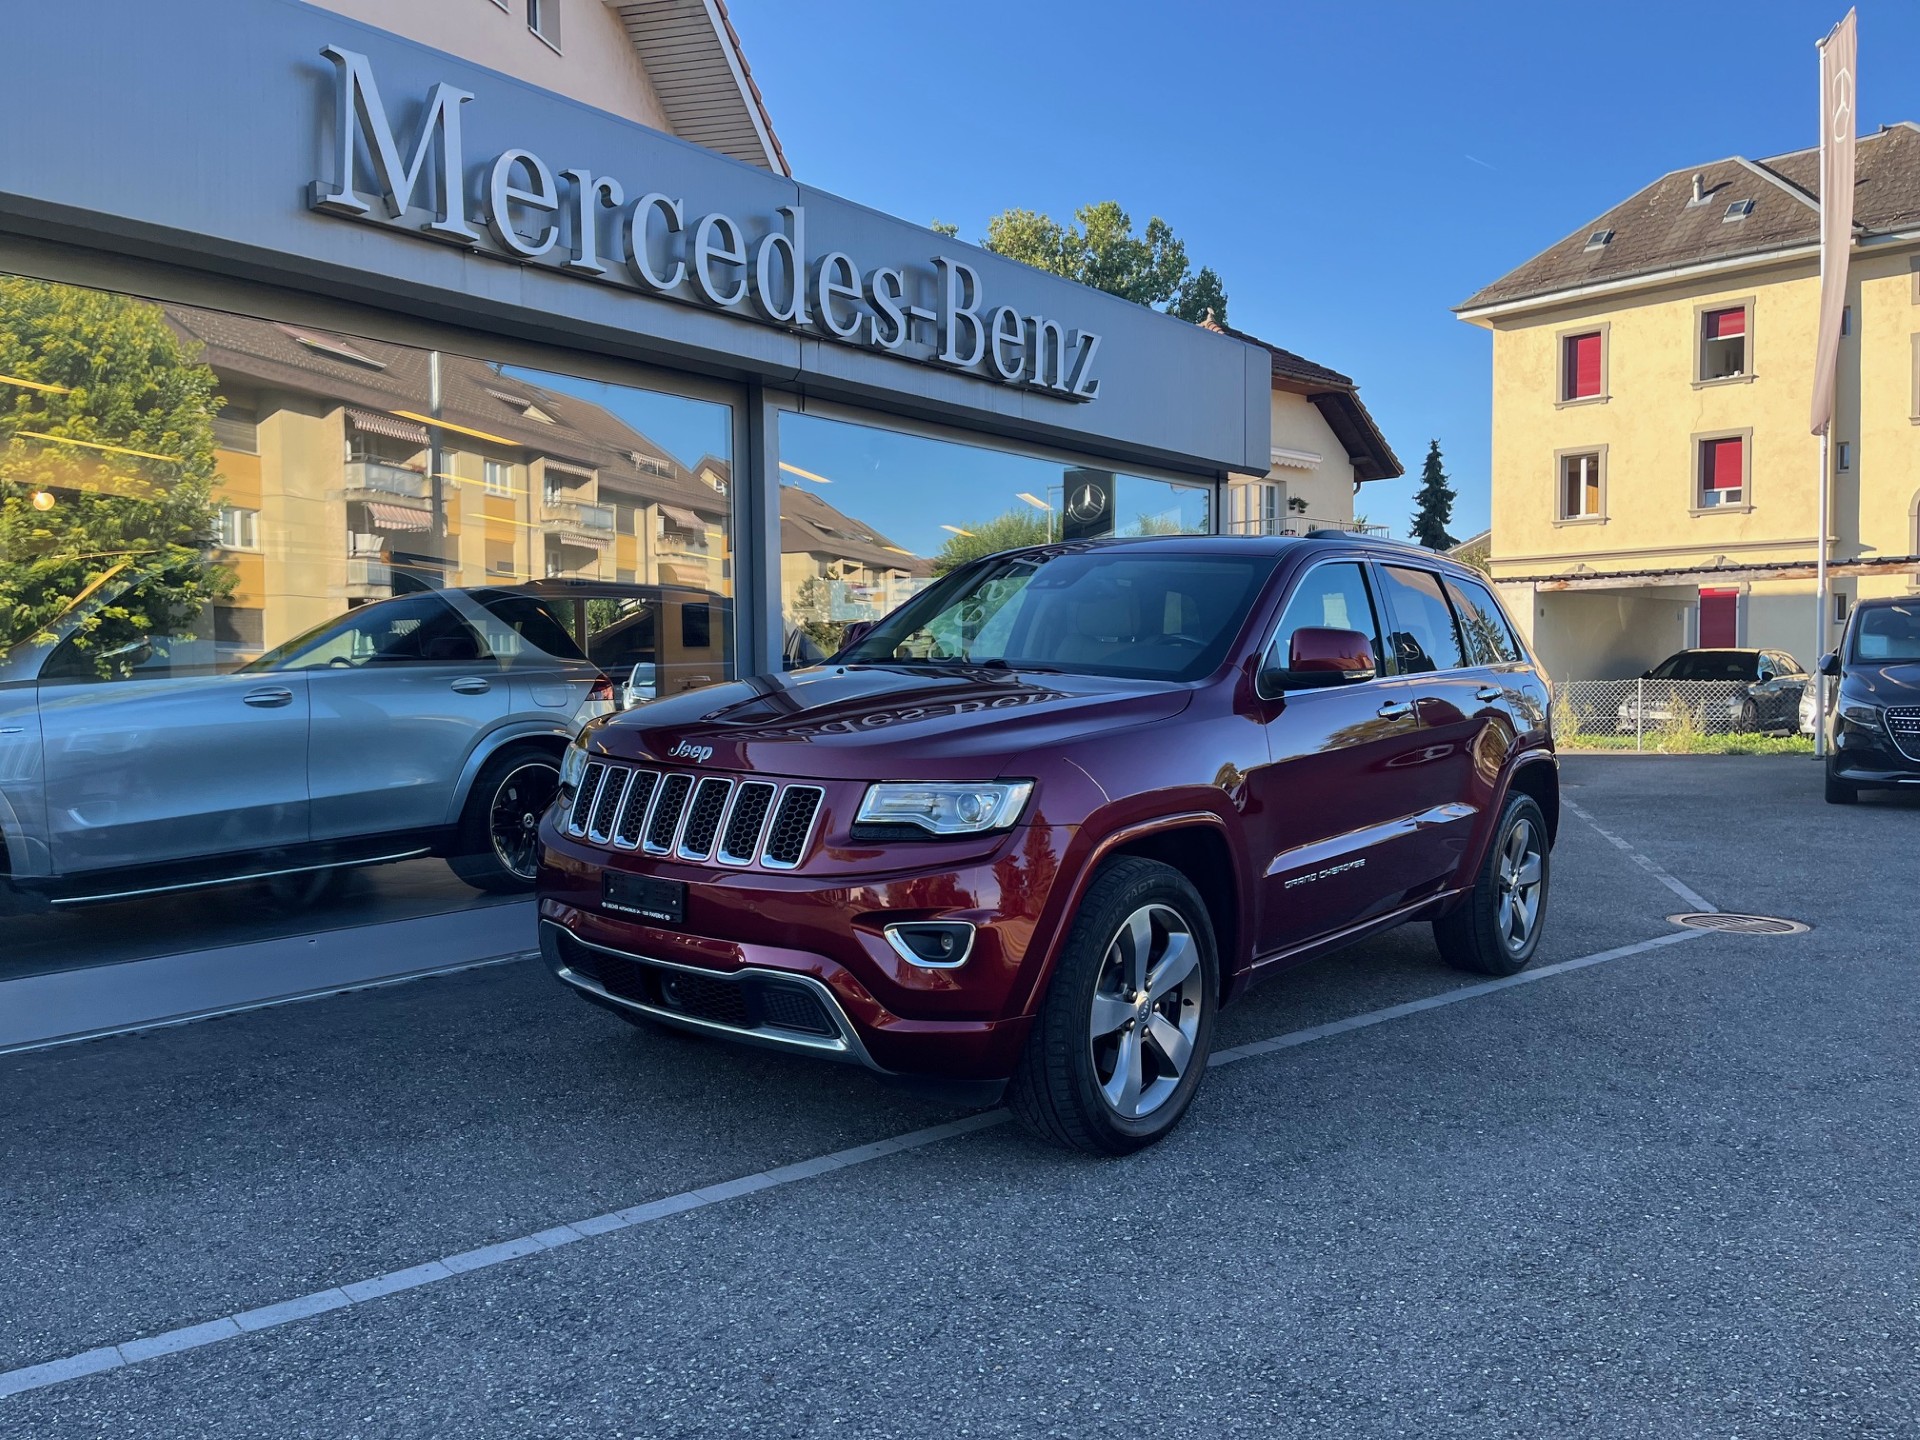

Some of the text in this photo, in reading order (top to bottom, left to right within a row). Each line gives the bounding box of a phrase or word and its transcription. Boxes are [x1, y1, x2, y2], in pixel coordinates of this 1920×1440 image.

[307, 44, 1103, 402] Mercedes-Benz
[667, 739, 714, 764] Jeep
[1284, 858, 1366, 889] GRAND CHEROKEE
